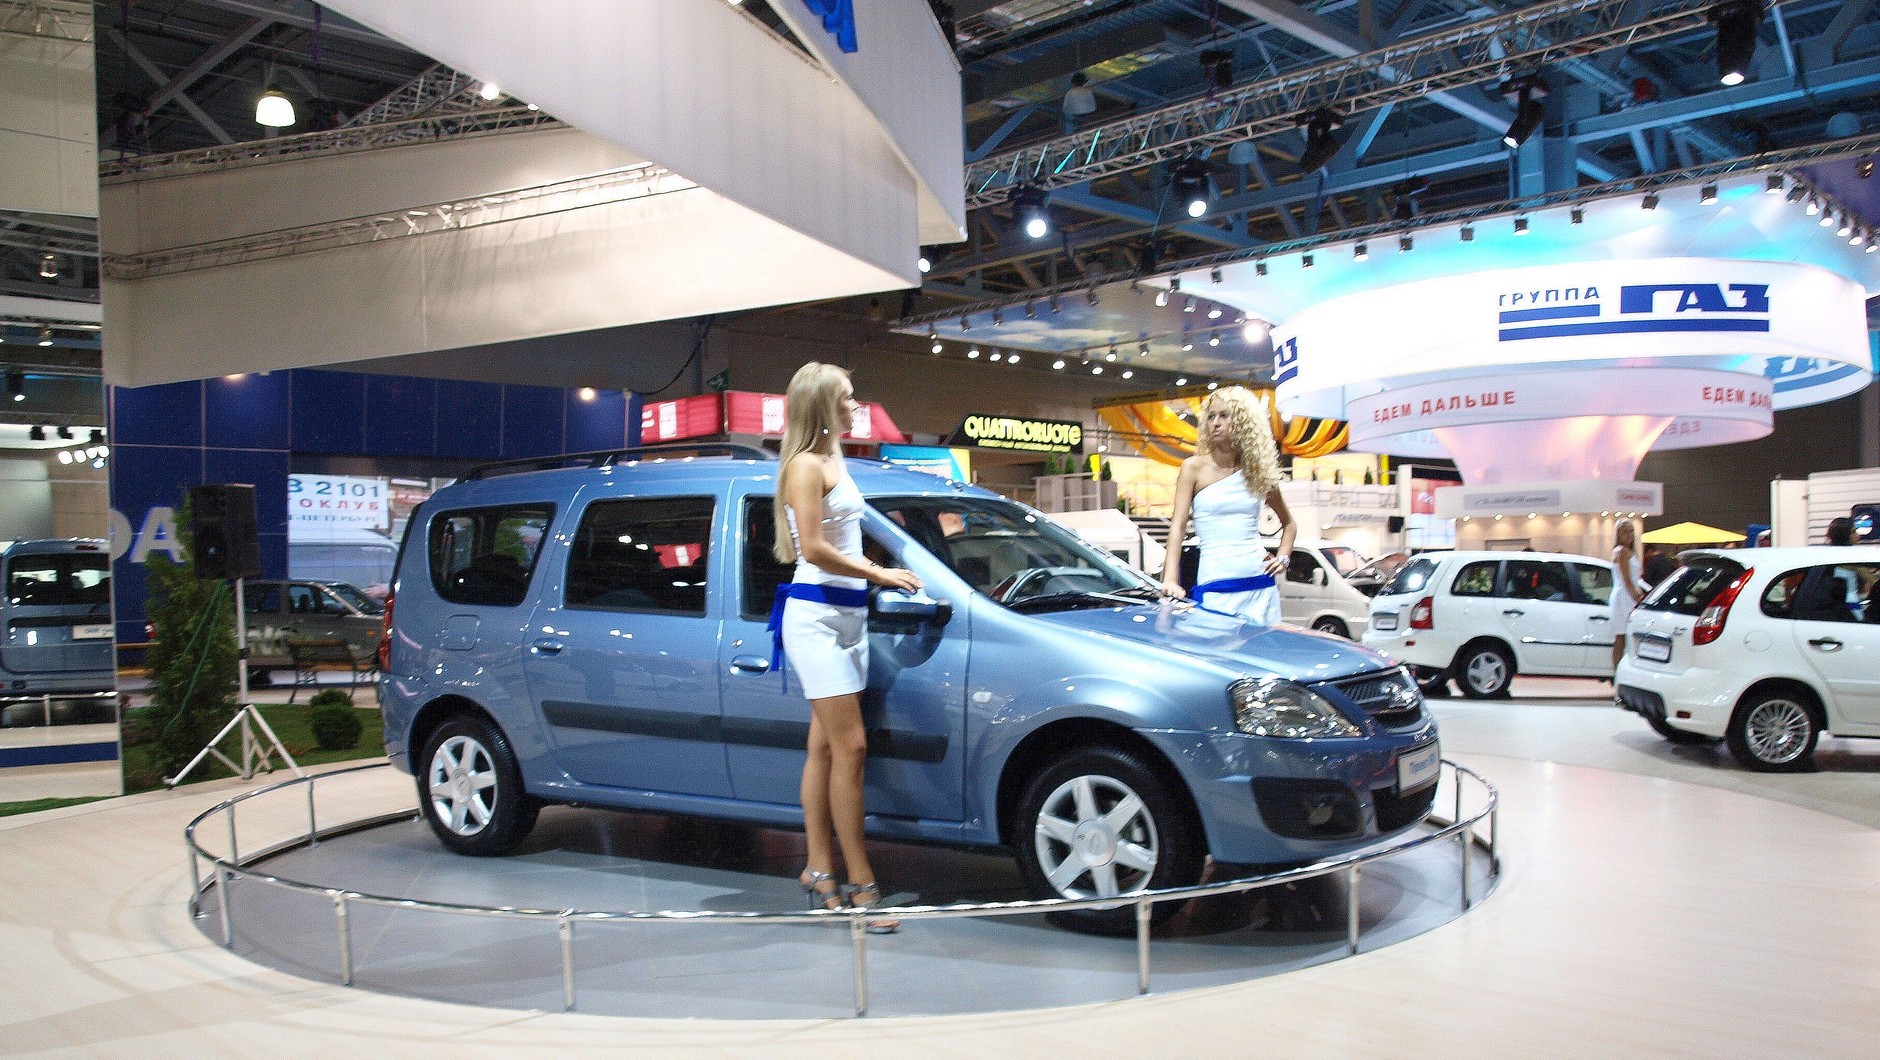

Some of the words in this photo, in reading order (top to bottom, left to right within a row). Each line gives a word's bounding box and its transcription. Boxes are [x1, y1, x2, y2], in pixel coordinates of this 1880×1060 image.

[1499, 287, 1600, 307] ГРУППА
[1620, 283, 1769, 314] ГАЗ
[1373, 403, 1412, 424] ЕДЕМ
[1420, 390, 1516, 416] ДАЛЬШЕ
[315, 481, 379, 498] 2101
[288, 498, 379, 511] ОКЛУБ
